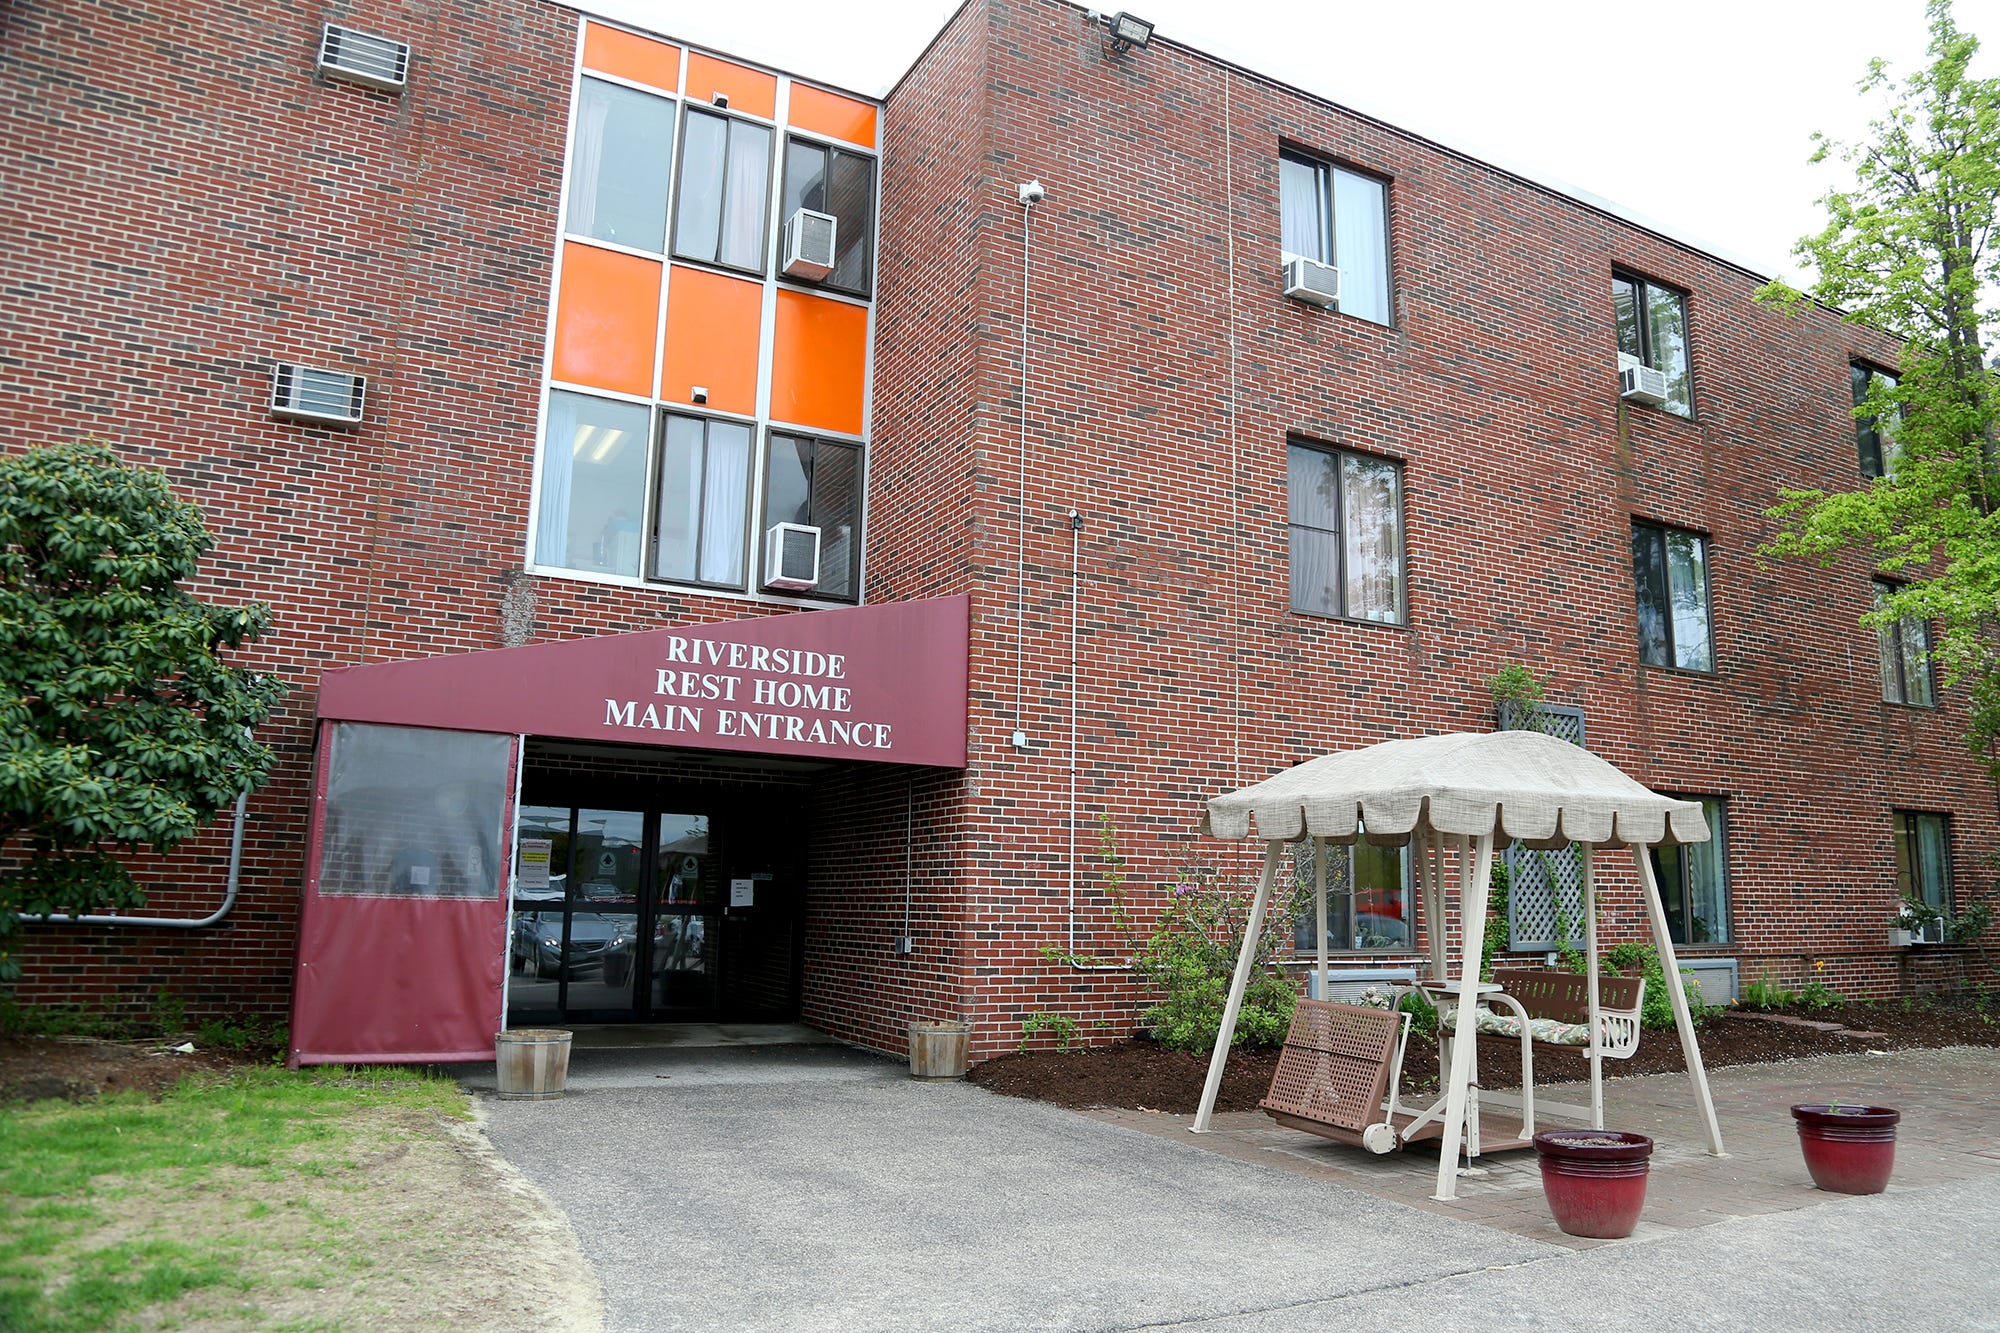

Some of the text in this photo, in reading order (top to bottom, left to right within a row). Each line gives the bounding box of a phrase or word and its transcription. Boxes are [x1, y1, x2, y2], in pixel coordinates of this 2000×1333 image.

[665, 635, 846, 680] RIVERSIDE
[654, 668, 852, 713] REST HOME
[603, 698, 893, 749] MAIN ENTRANCE
